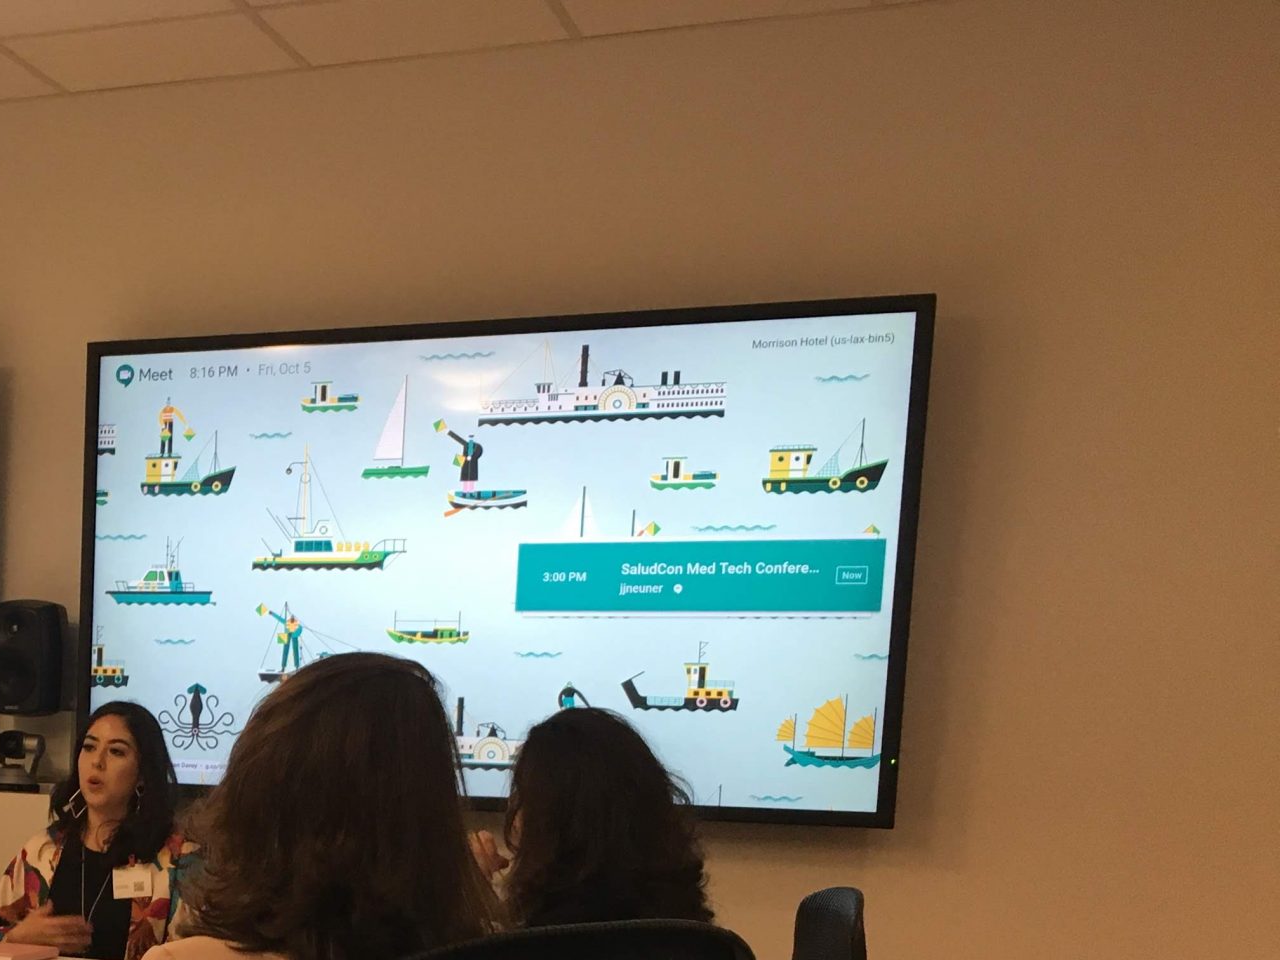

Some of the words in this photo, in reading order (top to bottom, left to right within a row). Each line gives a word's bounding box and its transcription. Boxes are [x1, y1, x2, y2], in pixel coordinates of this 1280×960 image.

[752, 338, 797, 349] Morrison
[800, 335, 828, 347] Hotel
[830, 332, 895, 347] (us-lax-bin5)
[138, 368, 173, 382] Meet
[189, 366, 215, 379] 8:16
[218, 365, 238, 377] PM
[258, 363, 276, 376] Fri,
[279, 362, 299, 375] Oct
[303, 361, 311, 374] 5
[621, 562, 683, 576] SaludCon
[686, 562, 716, 575] Med
[719, 561, 752, 575] Tech
[755, 561, 820, 575] Confere...
[842, 570, 862, 580] Now
[542, 571, 566, 582] 3:00
[568, 571, 587, 582] PM
[619, 582, 663, 596] jjneuner
